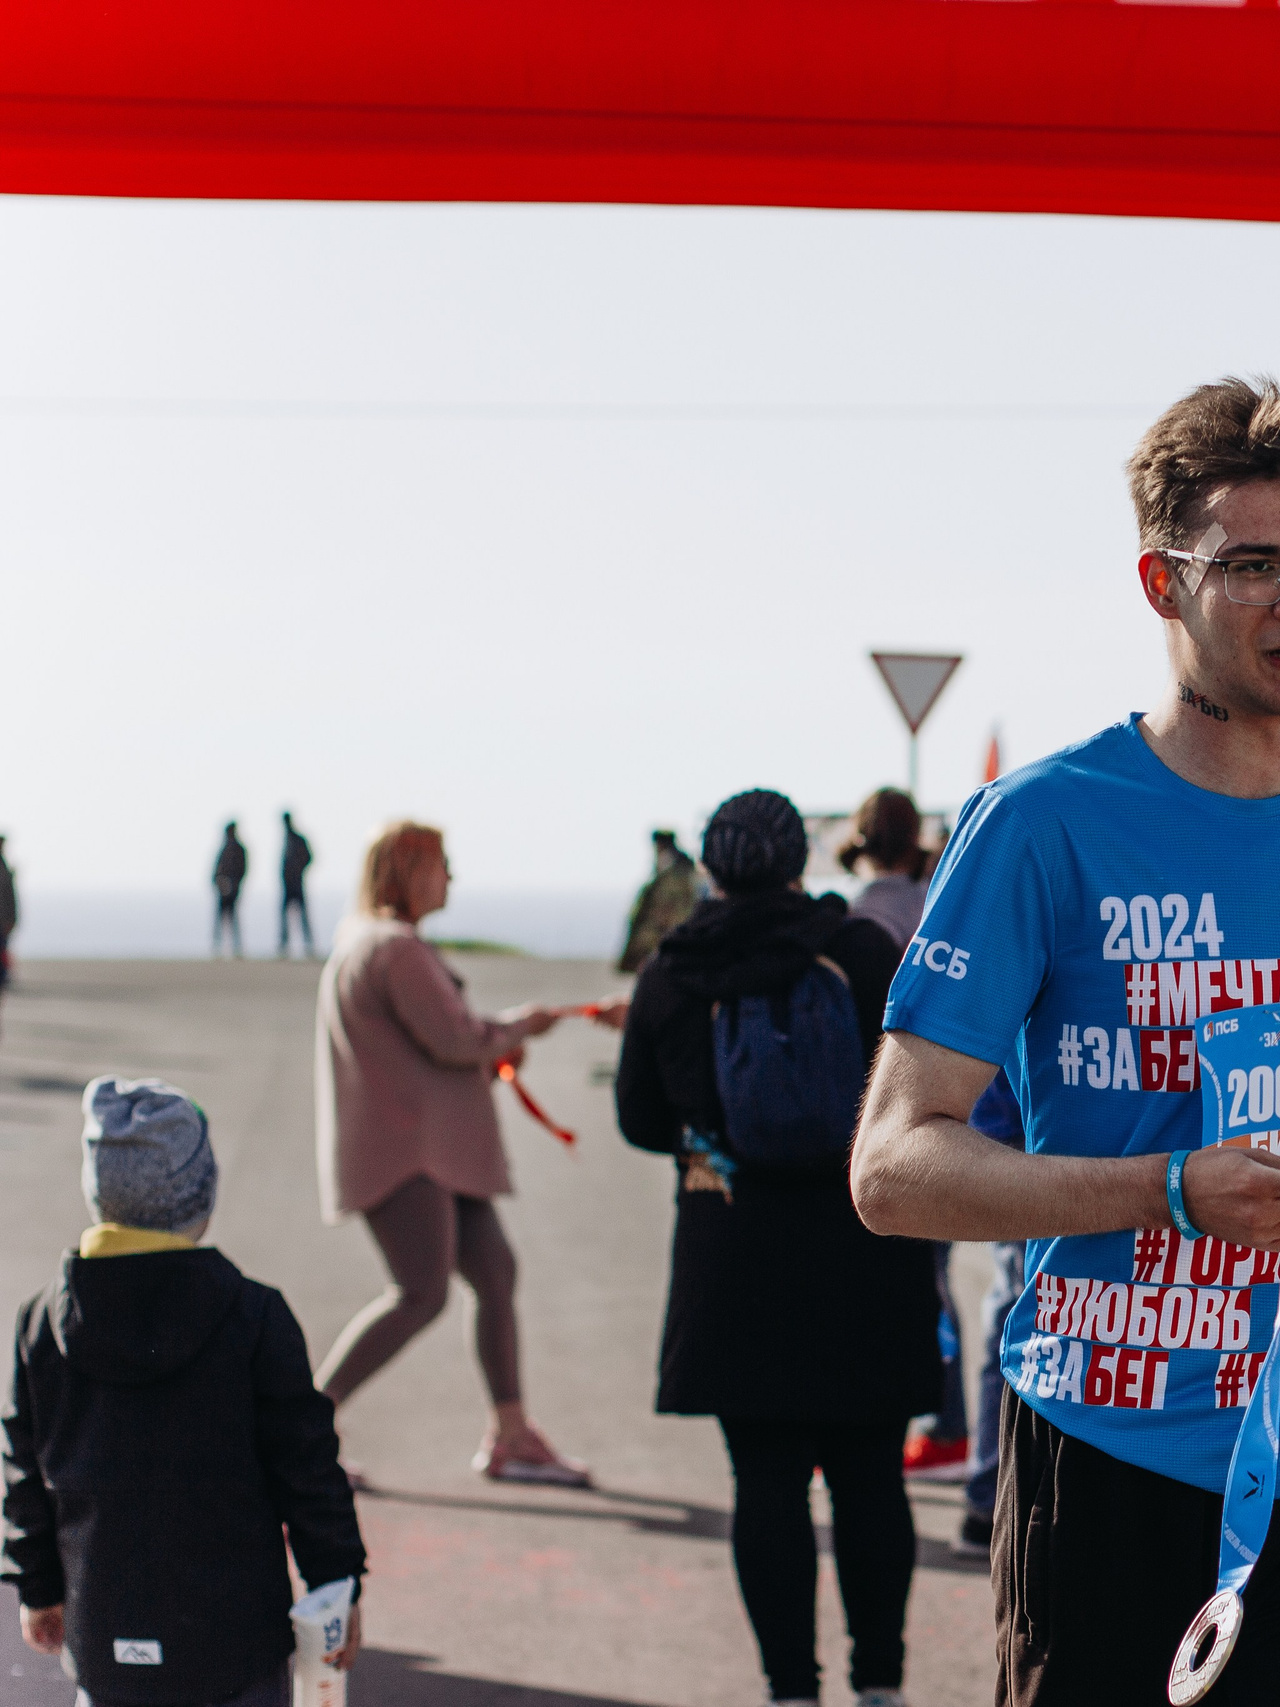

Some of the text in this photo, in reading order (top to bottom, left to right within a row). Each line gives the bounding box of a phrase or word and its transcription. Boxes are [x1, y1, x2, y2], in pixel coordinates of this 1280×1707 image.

[1100, 893, 1224, 960] 2024
[1058, 1023, 1200, 1093] #ЗАБЕ
[1215, 1018, 1239, 1036] ПСБ
[1036, 1273, 1250, 1350] #ЛЮБОВЬ
[1017, 1333, 1168, 1410] #ЗАБЕГ
